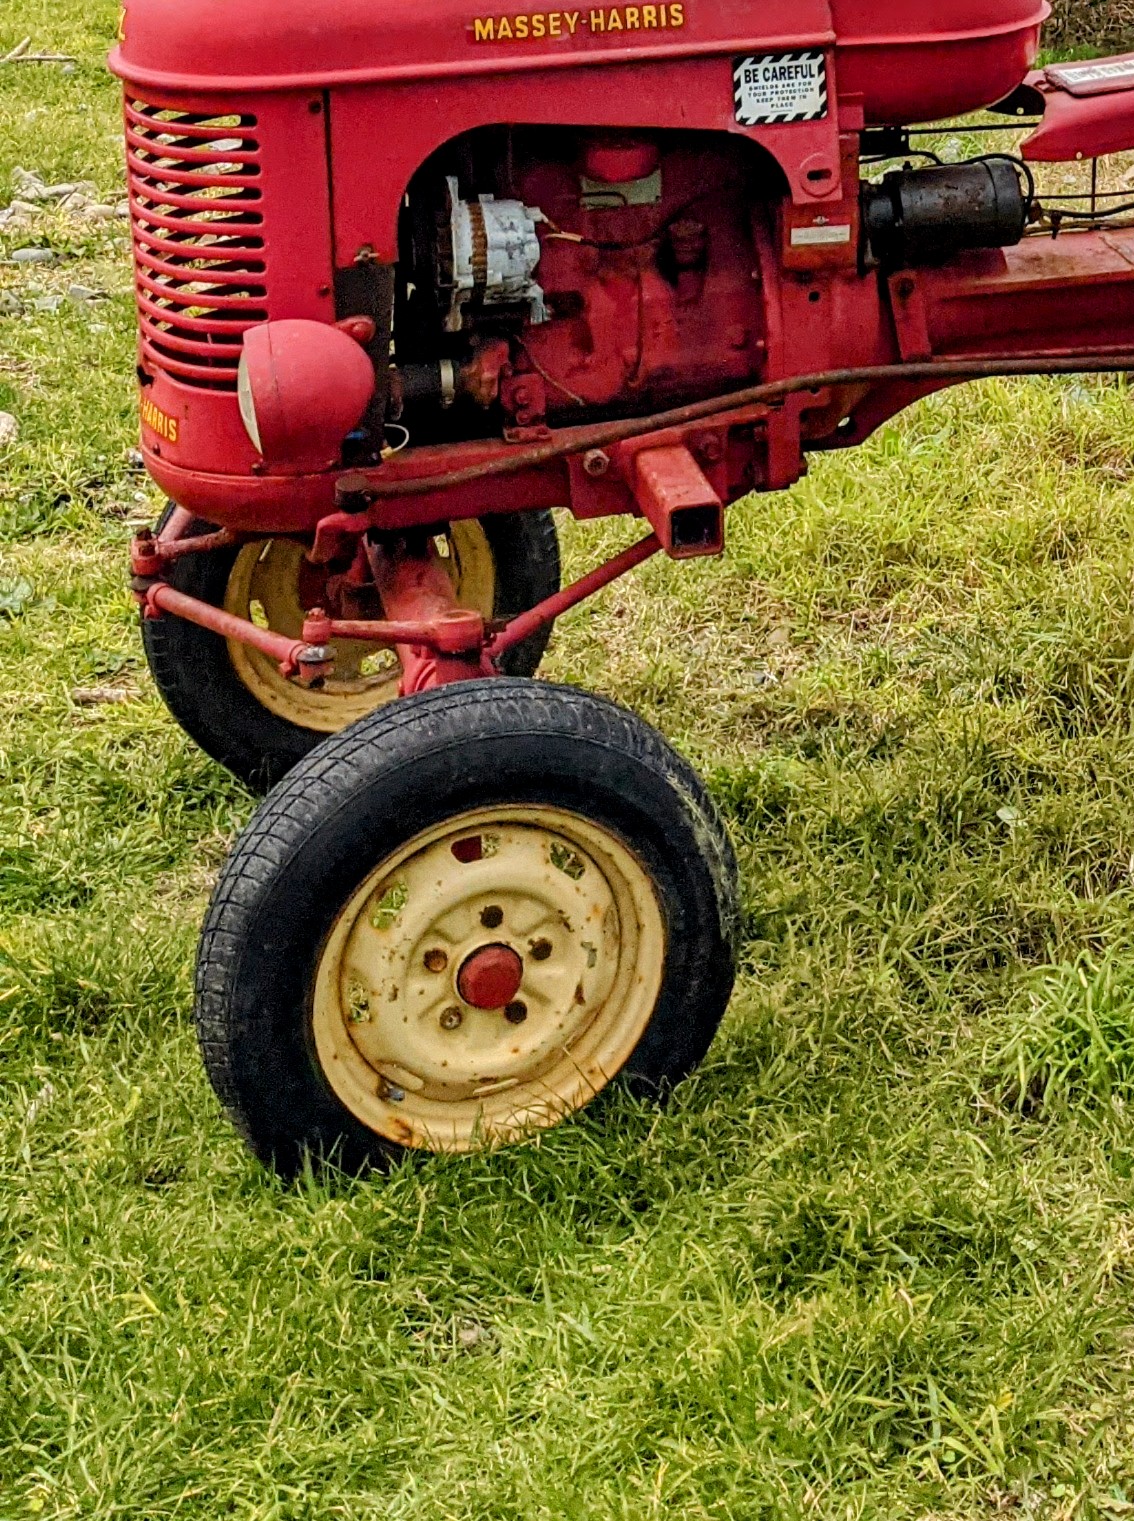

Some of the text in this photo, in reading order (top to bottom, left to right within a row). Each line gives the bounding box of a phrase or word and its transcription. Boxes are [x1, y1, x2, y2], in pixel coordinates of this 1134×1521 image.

[474, 3, 684, 41] MASSEY-HARRIS
[744, 64, 815, 84] BE CAREFUL
